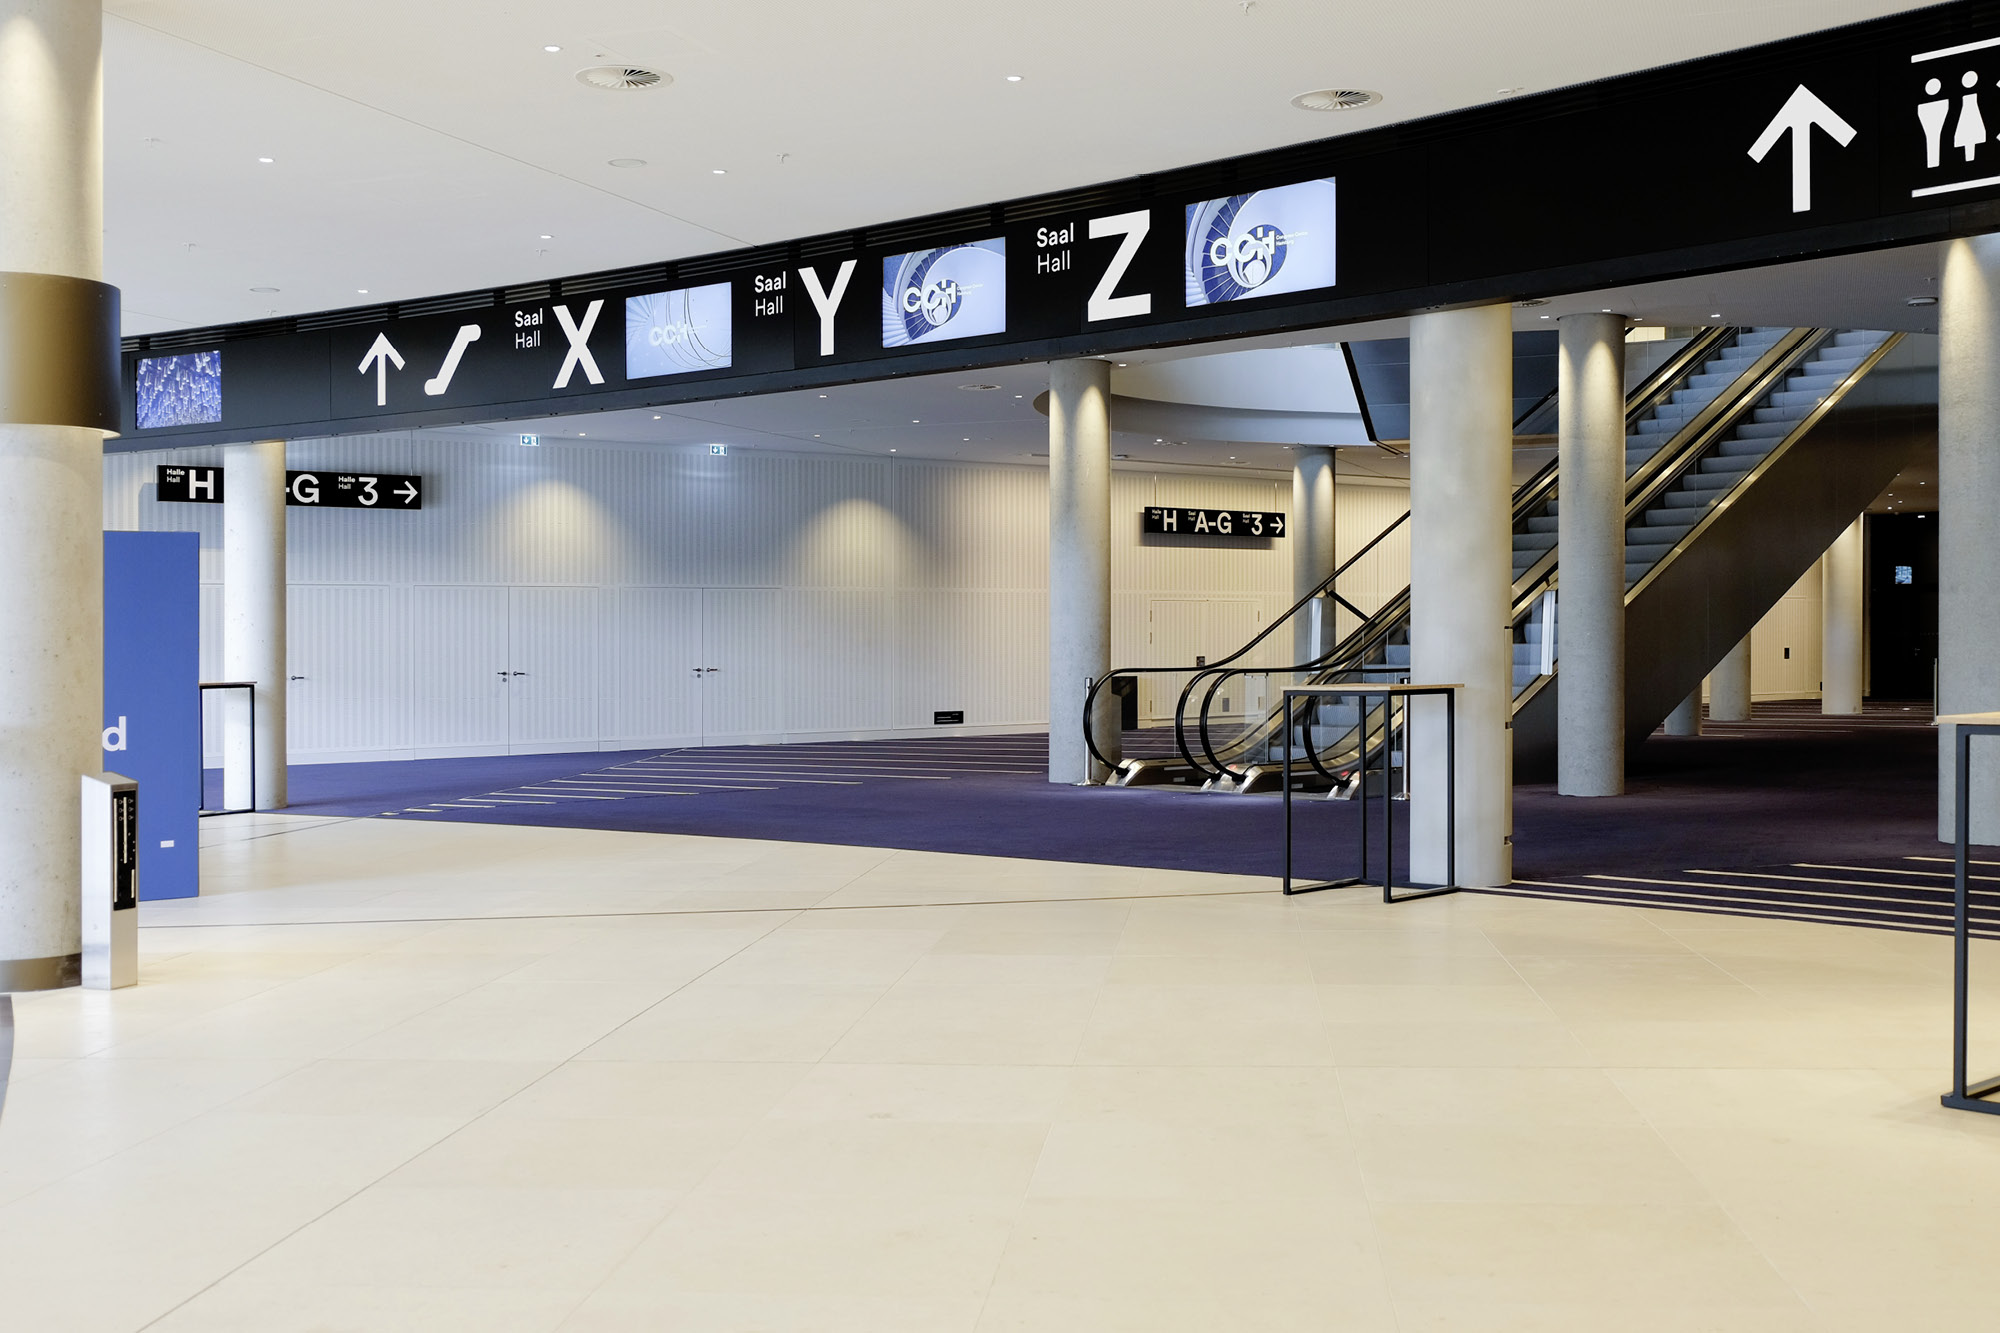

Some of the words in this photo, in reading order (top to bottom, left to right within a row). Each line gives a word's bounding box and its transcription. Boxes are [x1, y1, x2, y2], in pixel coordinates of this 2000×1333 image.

[1036, 222, 1074, 248] Saal
[1037, 249, 1071, 275] Hall
[1087, 209, 1152, 322] Z
[754, 270, 787, 294] Saal
[514, 307, 543, 328] Saal
[755, 295, 784, 317] Hall
[797, 259, 858, 357] Y
[515, 329, 541, 350] Hall
[552, 299, 606, 390] X
[166, 468, 185, 476] Halle
[189, 469, 214, 500] H
[357, 476, 379, 506] 3
[1163, 509, 1177, 532] H
[1194, 511, 1232, 534] A-G
[1251, 513, 1263, 535] 3
